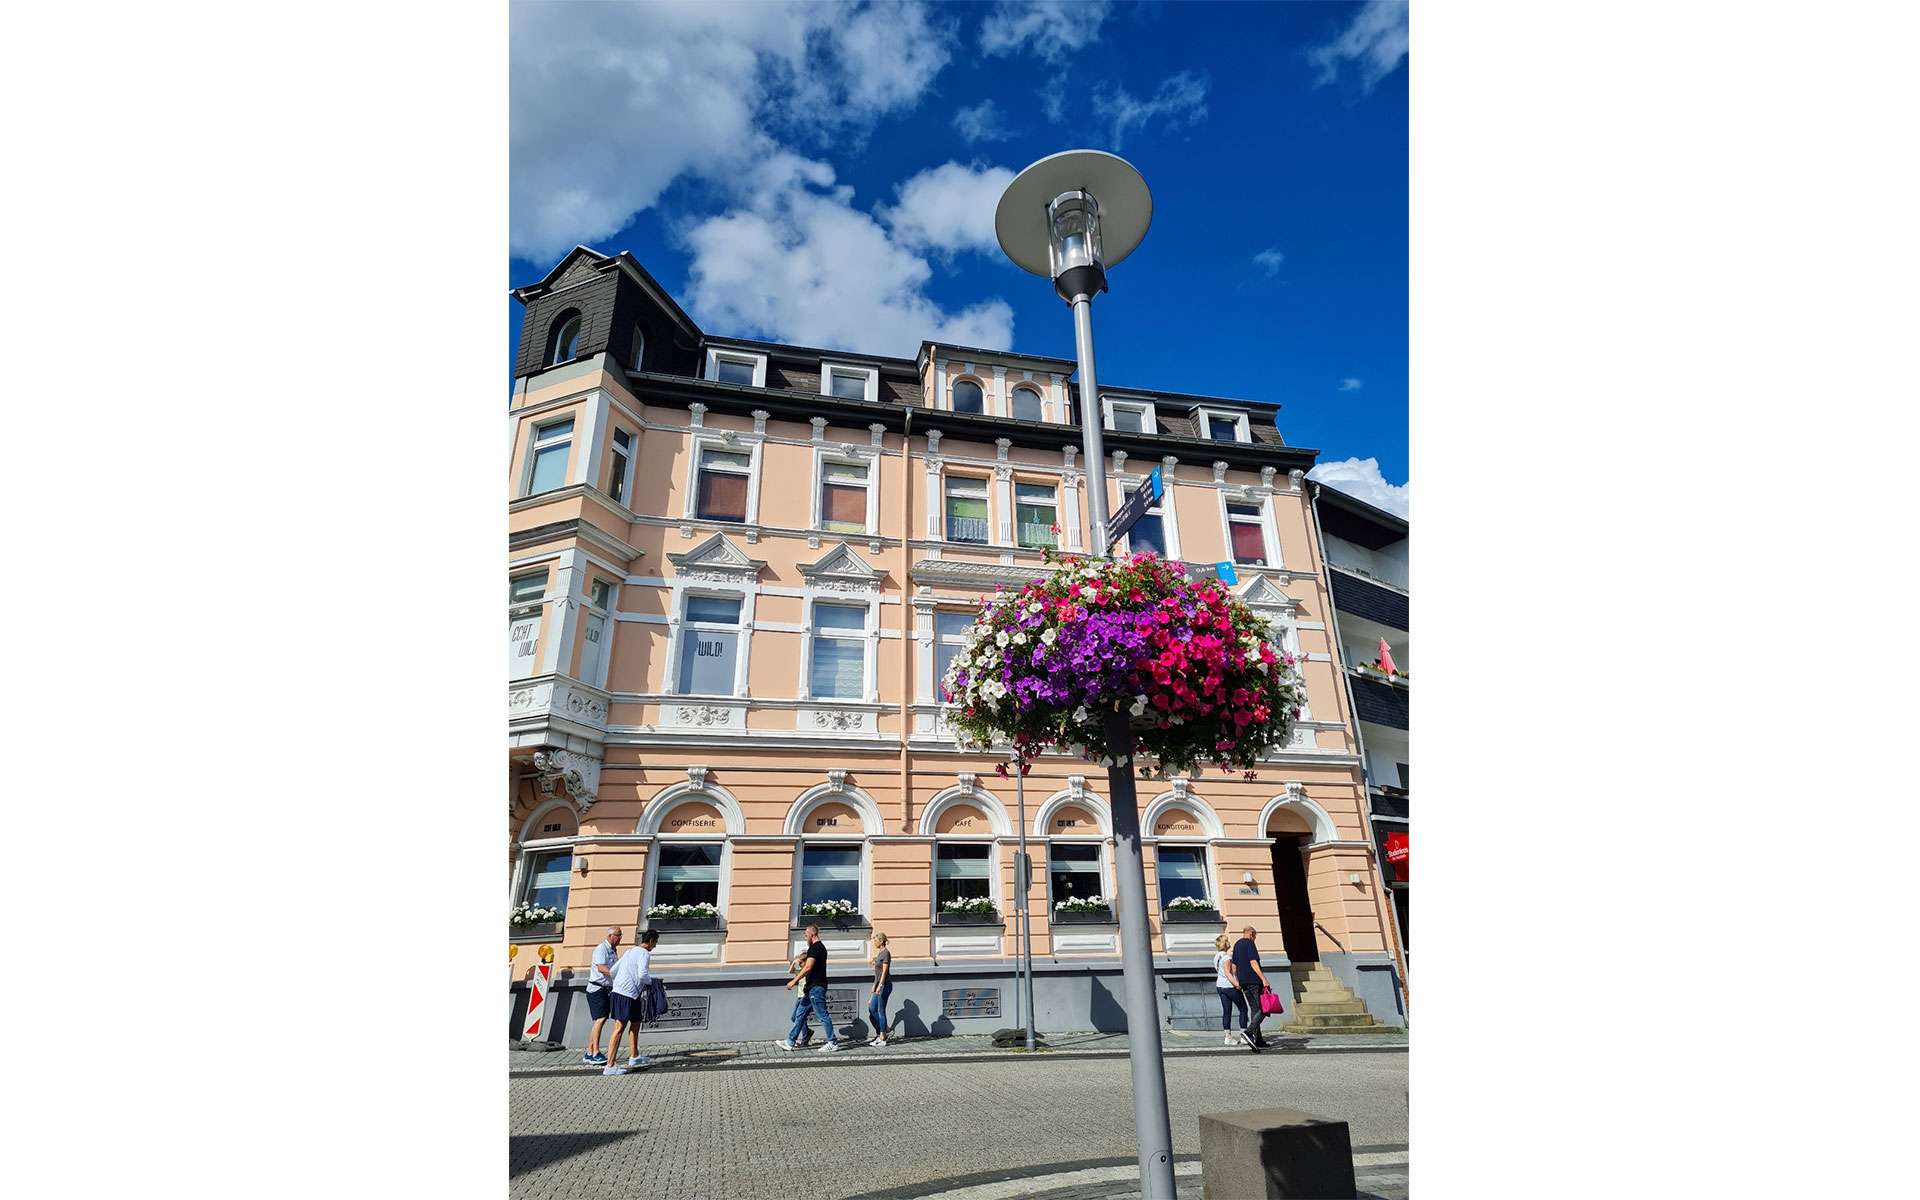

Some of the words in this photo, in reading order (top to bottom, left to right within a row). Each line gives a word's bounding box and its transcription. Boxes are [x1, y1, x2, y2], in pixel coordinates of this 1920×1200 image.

[511, 623, 533, 642] ECHT
[698, 640, 723, 658] WILD!
[671, 819, 717, 827] CONFISERIE
[954, 819, 972, 828] CAFÉ
